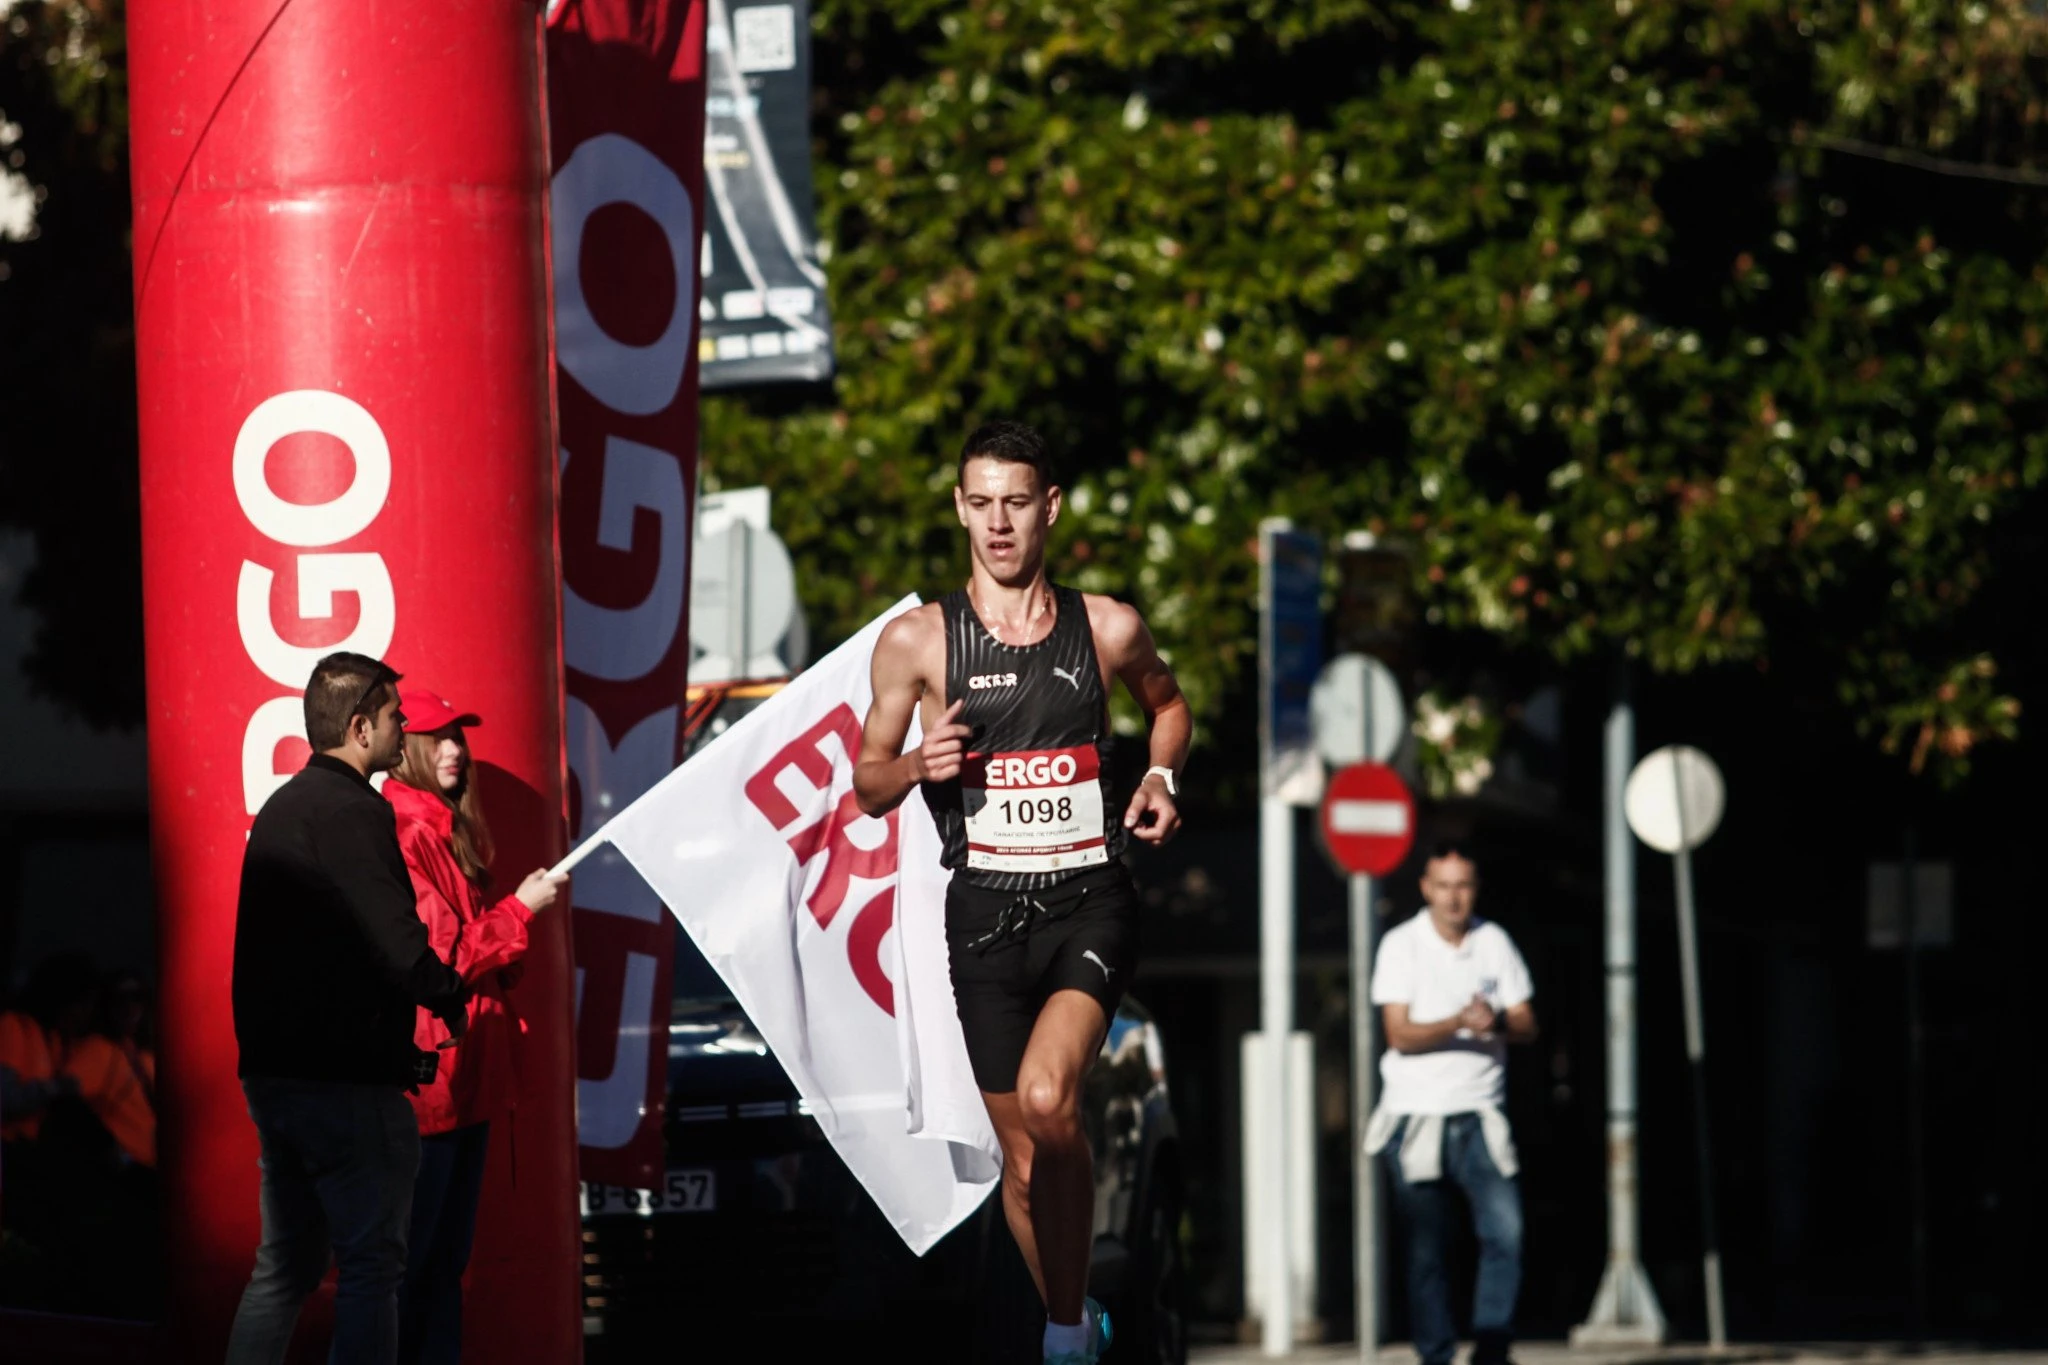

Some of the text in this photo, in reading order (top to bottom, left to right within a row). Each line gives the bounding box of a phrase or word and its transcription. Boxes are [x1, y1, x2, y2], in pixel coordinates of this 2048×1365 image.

[233, 389, 395, 838] GO
[985, 754, 1077, 786] ERGO
[1000, 797, 1072, 824] 1098
